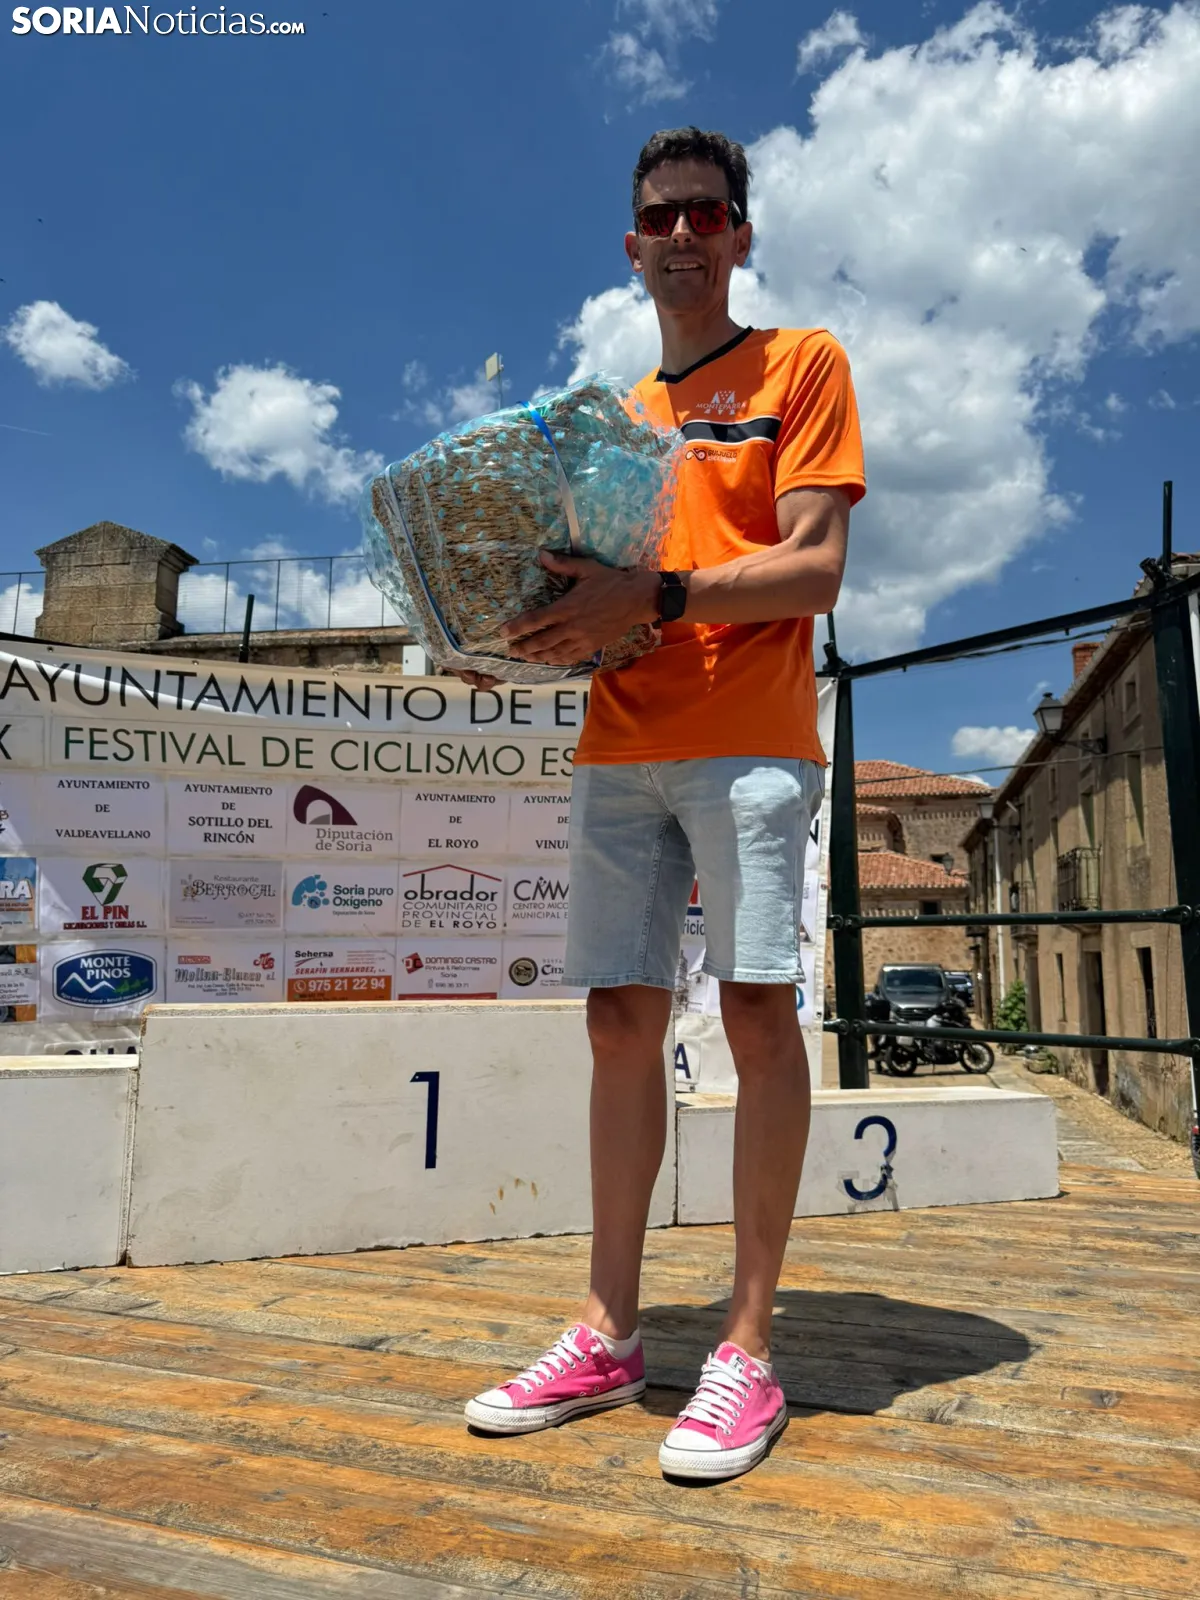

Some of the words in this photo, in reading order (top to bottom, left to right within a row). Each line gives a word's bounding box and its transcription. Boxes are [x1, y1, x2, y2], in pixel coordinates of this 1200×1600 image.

[1, 658, 447, 722] AYUNTAMIENTO
[470, 688, 532, 725] DE
[64, 726, 246, 766] FESTIVAL
[262, 736, 314, 770] DE
[330, 739, 525, 777] CICLISMO
[57, 779, 150, 790] AYUNTAMIENTO
[184, 783, 273, 796] AYUNTAMIENTO
[415, 793, 496, 804] AYUNTAMIENTO
[95, 804, 110, 813] DE
[221, 802, 236, 811] DE
[188, 816, 244, 828] SOTILLO
[247, 818, 273, 829] DEL
[449, 816, 462, 824] DE
[557, 816, 570, 824] DE
[55, 828, 151, 840] VALDEAVELLANO
[203, 831, 255, 844] RINCÓN
[316, 828, 393, 842] Diputación
[315, 840, 334, 851] de
[336, 840, 373, 852] Soria
[428, 838, 442, 848] EL
[446, 838, 479, 849] ROYO
[333, 884, 364, 896] Soria
[368, 886, 394, 897] puro
[403, 873, 498, 901] obrador
[402, 901, 498, 911] COMUNITARIO
[512, 902, 546, 910] CENTRO
[81, 905, 99, 920] EL
[103, 905, 129, 920] PIN
[402, 910, 497, 920] PROVINCIAL
[512, 911, 560, 919] MUNICIPAL
[402, 919, 423, 928] DE
[430, 919, 445, 928] EL
[453, 920, 497, 929] ROYO
[295, 950, 334, 958] Sehersa
[80, 956, 131, 969] MONTE
[425, 956, 464, 965] DOMINGO
[465, 956, 498, 965] CASTRO
[86, 968, 131, 980] PINOS
[308, 979, 331, 992] 975
[334, 979, 348, 991] 21
[352, 978, 367, 990] 22
[370, 977, 386, 989] 94
[410, 1071, 440, 1169] 1
[843, 1115, 897, 1201] 3
